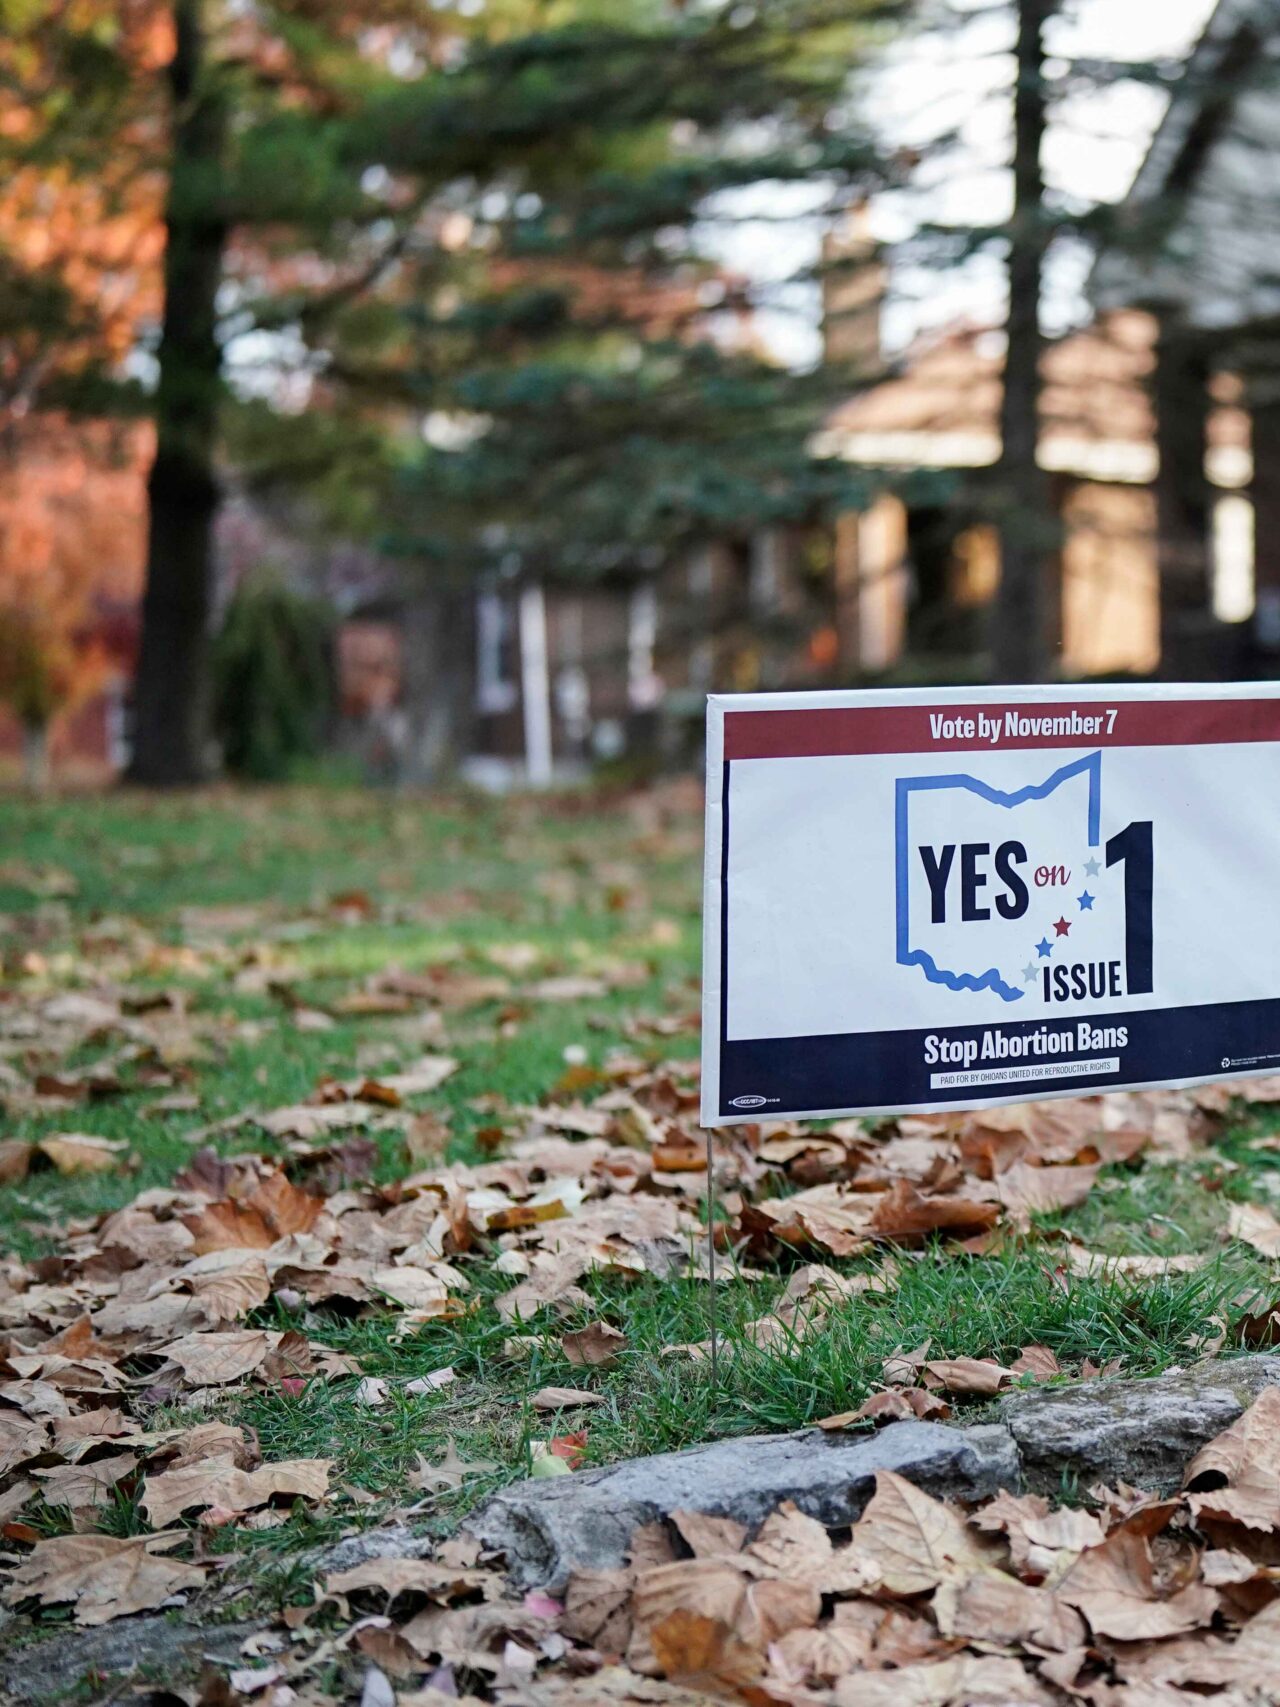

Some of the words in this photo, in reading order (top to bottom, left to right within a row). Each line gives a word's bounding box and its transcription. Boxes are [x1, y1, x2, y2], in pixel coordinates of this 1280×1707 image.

[930, 712, 974, 740] Vote
[978, 711, 1002, 744] by
[1004, 710, 1104, 738] November
[1106, 709, 1118, 734] 7
[919, 840, 1029, 924] YES
[1034, 864, 1071, 887] on
[1106, 821, 1153, 995] 1
[1044, 961, 1122, 1002] ISSUE
[924, 1035, 977, 1068] Stop
[981, 1026, 1074, 1060] Abortion
[1077, 1023, 1128, 1051] Bans
[940, 1076, 955, 1085] PAID
[956, 1075, 969, 1084] FOR
[971, 1074, 979, 1082] BY
[980, 1071, 1007, 1081] OHIOANS
[1009, 1069, 1030, 1079] UNITED
[1032, 1068, 1043, 1077] FOR
[1045, 1064, 1088, 1076] REPRODUCTIVE
[1090, 1062, 1111, 1072] RIGHTS
